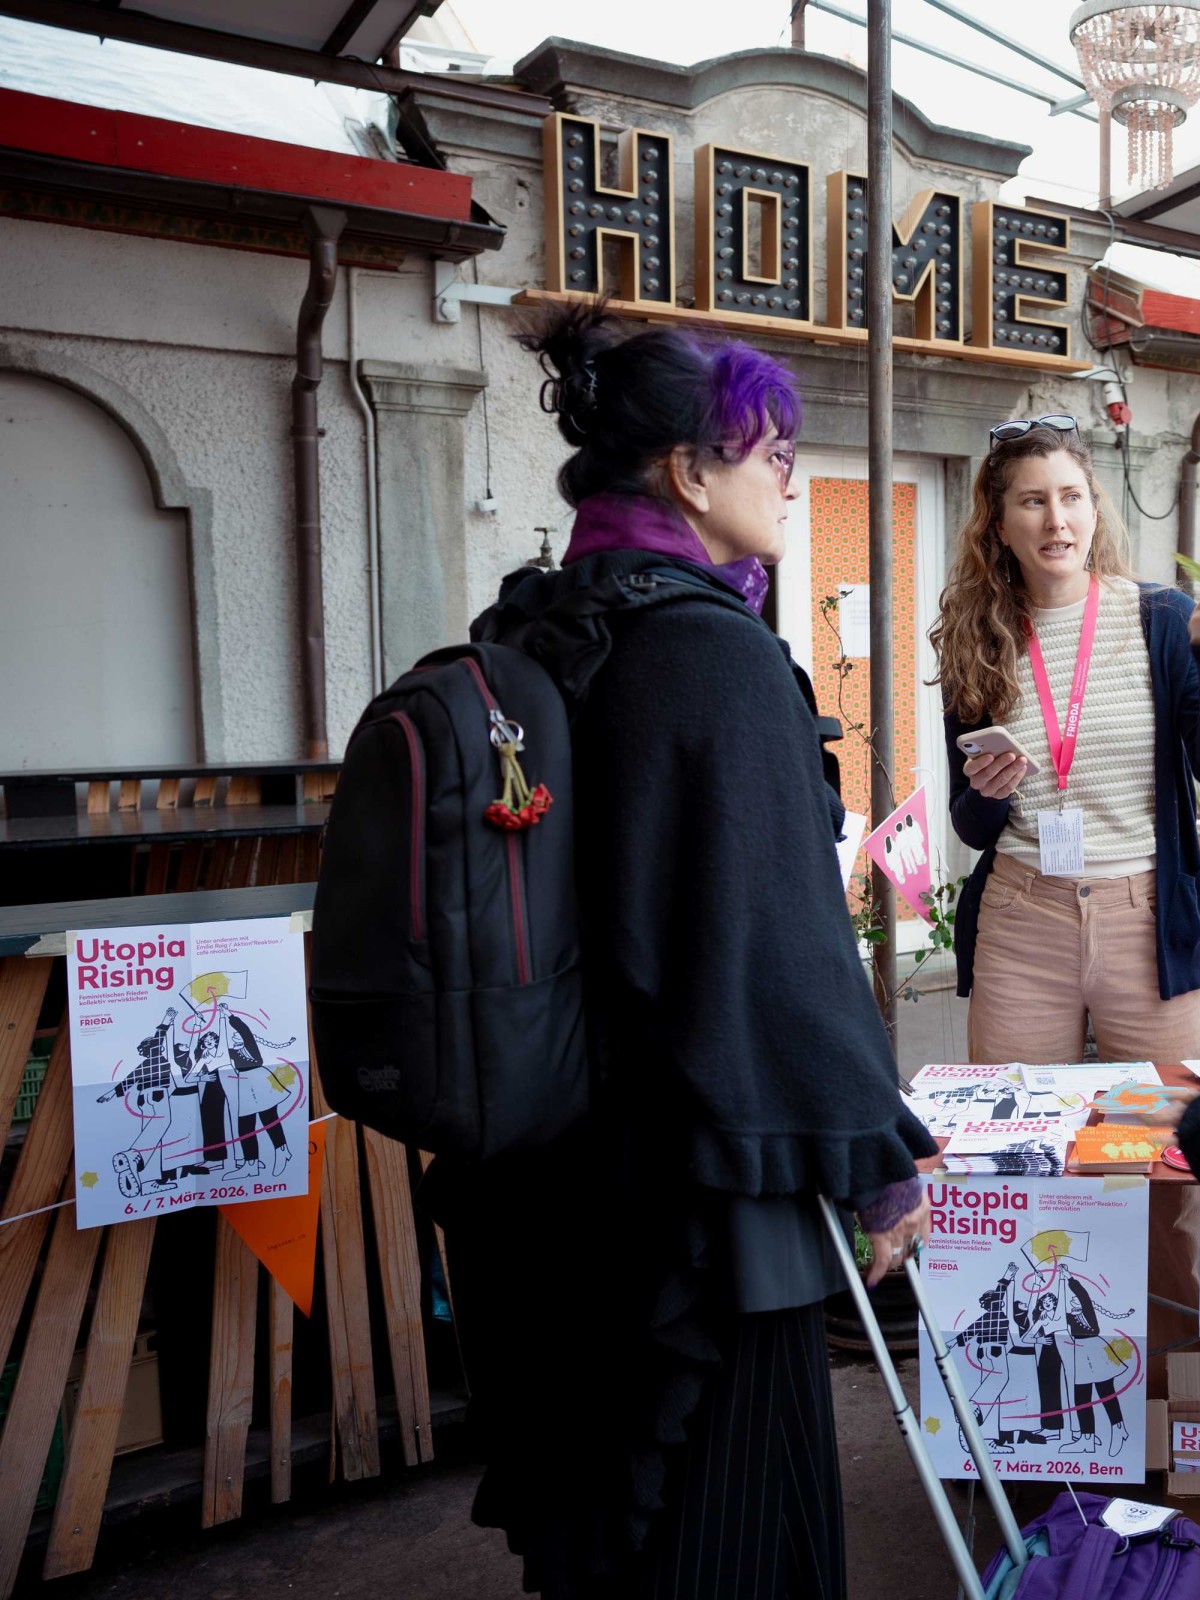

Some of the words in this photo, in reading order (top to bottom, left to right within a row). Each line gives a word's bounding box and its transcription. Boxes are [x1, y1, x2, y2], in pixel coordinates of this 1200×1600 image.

[543, 112, 1071, 360] HOME
[76, 934, 185, 966] Utopia
[78, 962, 174, 991] Rising
[79, 992, 125, 1000] Feministischen
[923, 1070, 997, 1078] Rising
[929, 1065, 1010, 1074] Utopia
[963, 1125, 1049, 1133] Rising
[966, 1118, 1061, 1127] Utopia
[124, 1203, 138, 1214] 6.
[170, 1191, 205, 1207] März
[210, 1185, 248, 1200] 2026,
[253, 1183, 287, 1195] Bern
[927, 1183, 1028, 1216] Utopia
[929, 1209, 1017, 1244] Rising
[963, 1459, 976, 1472] 6.
[1006, 1461, 1043, 1473] März
[1046, 1461, 1085, 1476] 2026,
[1089, 1462, 1124, 1475] Bern
